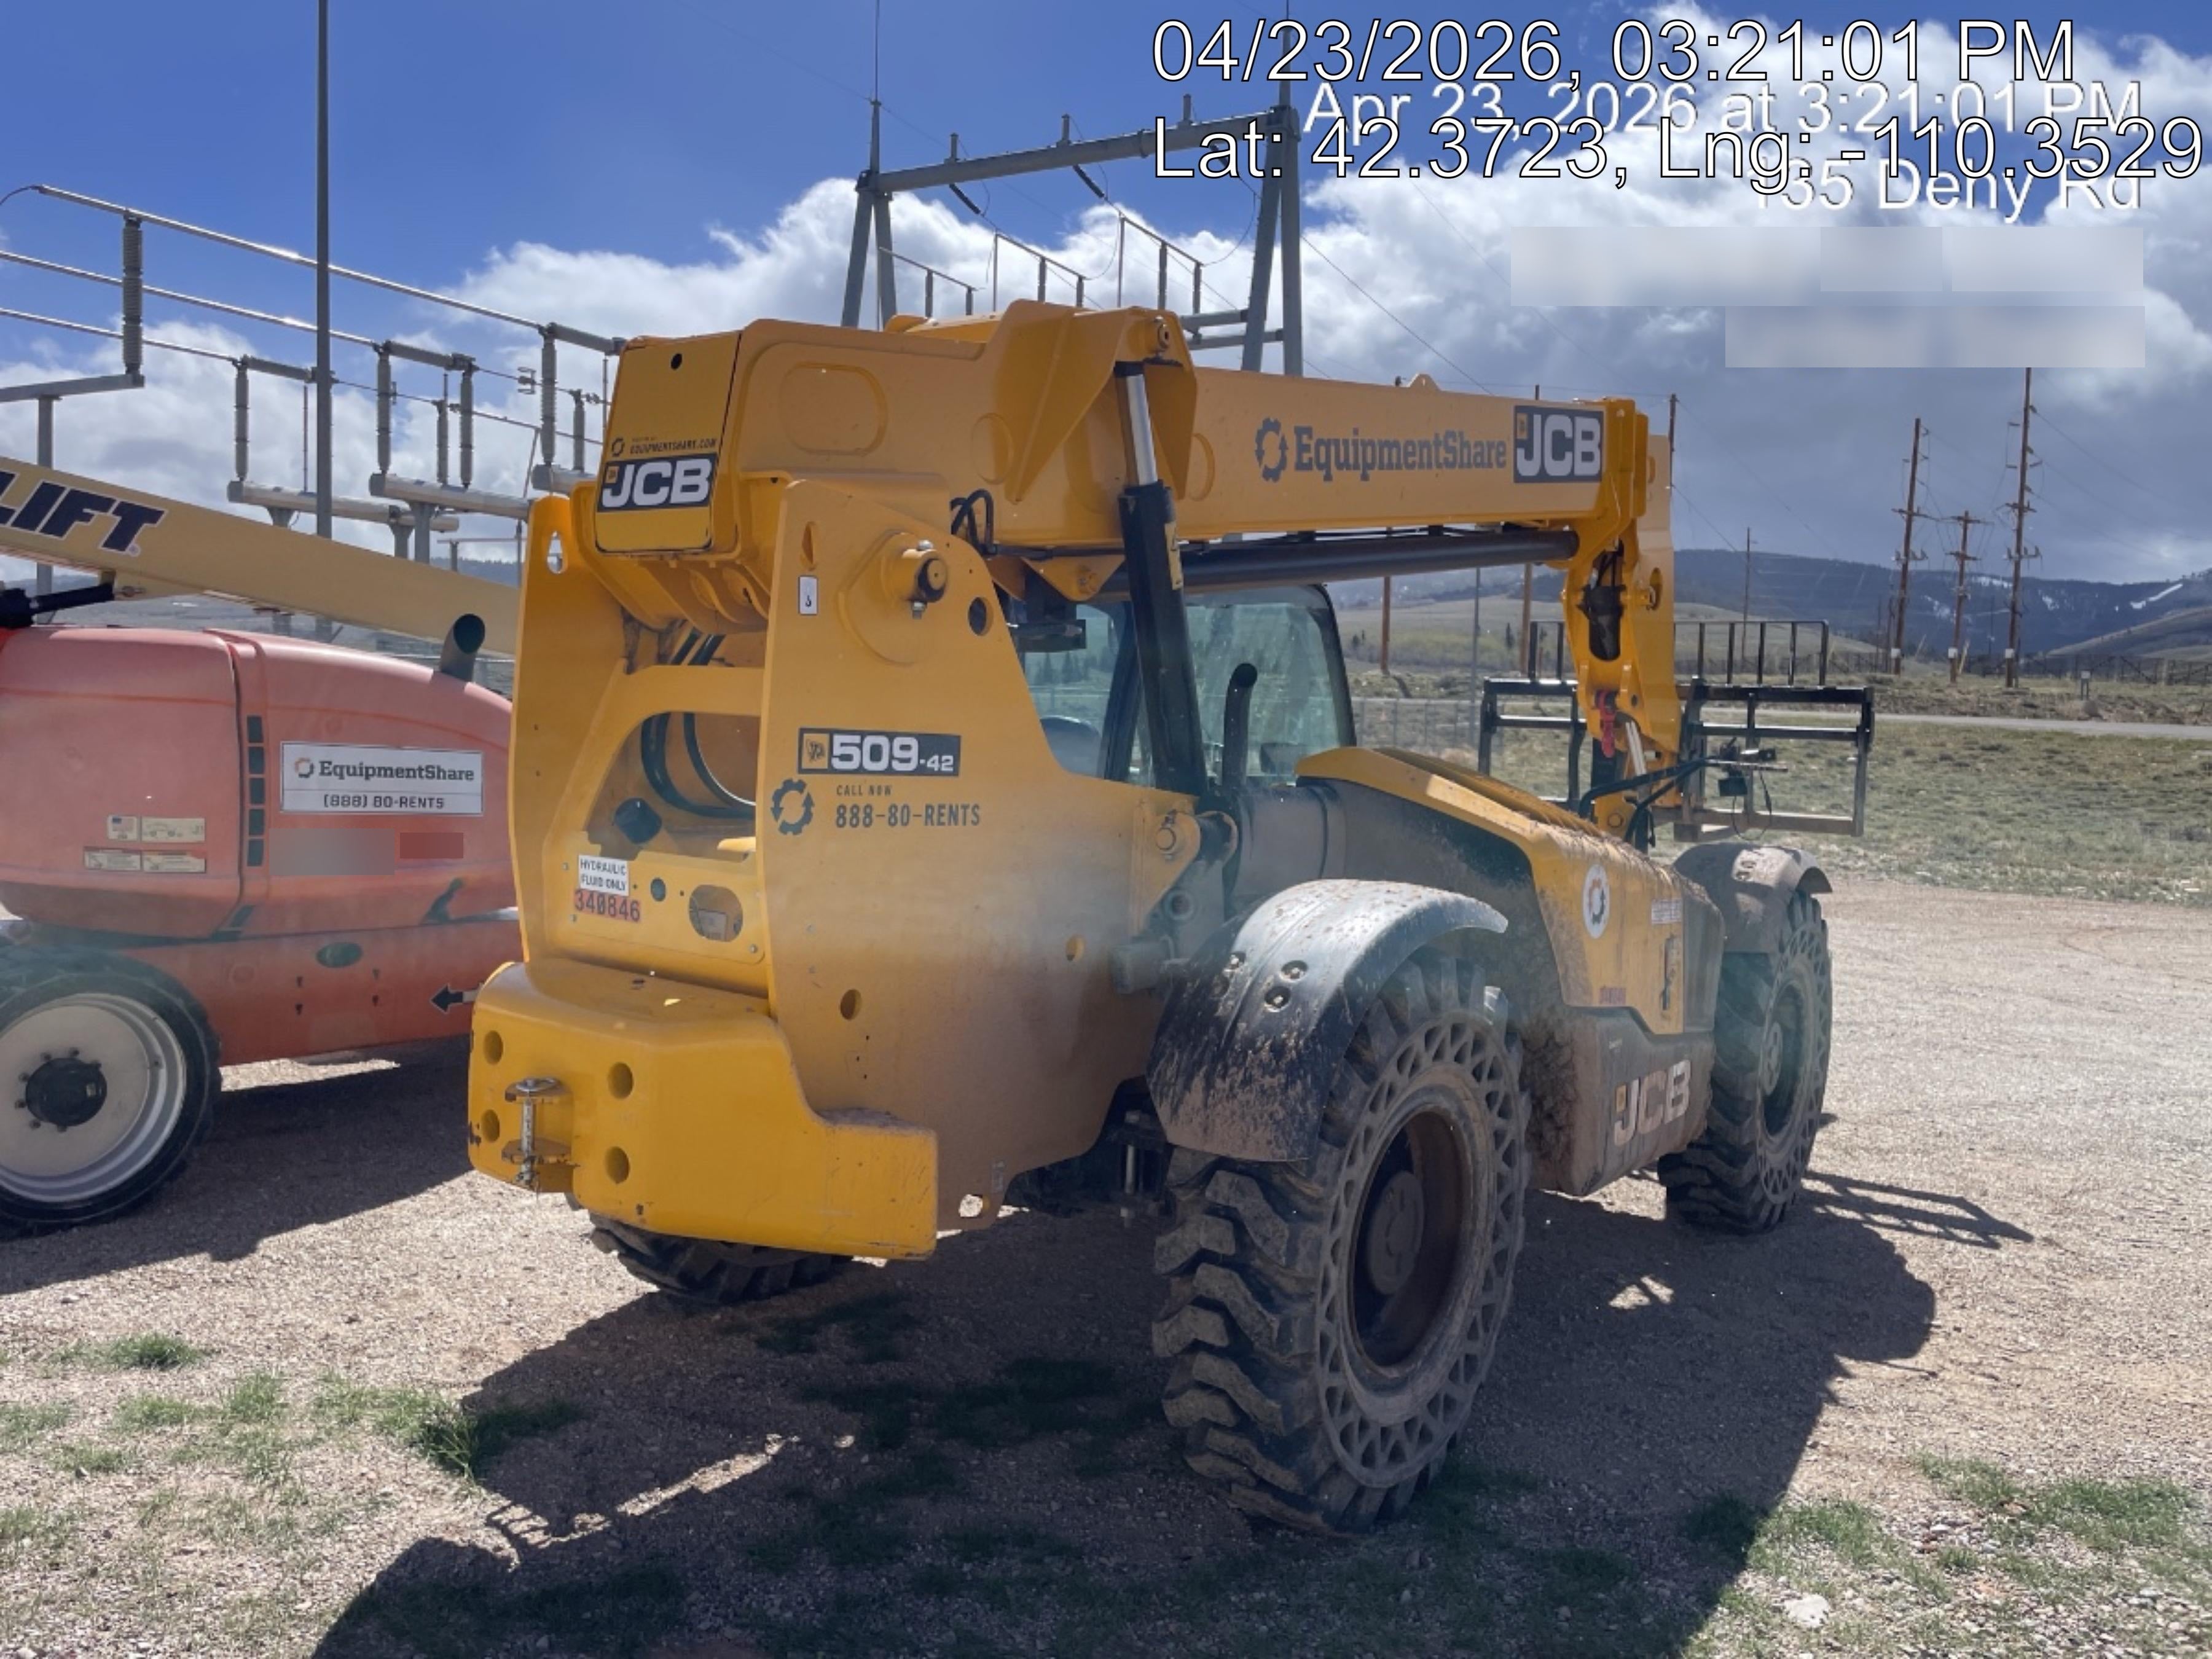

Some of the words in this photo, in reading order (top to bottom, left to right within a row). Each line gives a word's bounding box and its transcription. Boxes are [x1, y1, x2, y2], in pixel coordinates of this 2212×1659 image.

[1294, 426, 1507, 482] EquipmentShare
[1516, 414, 1601, 477] JCB
[602, 458, 712, 508] JCB
[319, 761, 474, 782] EquipmentShare
[324, 794, 367, 808] (888)
[373, 796, 444, 809] 80-RENTS
[836, 785, 863, 796] CALL
[868, 785, 893, 796] NOW
[836, 804, 981, 828] 888-80-RENTS
[580, 858, 626, 876] HYDRAULIC
[581, 873, 603, 887] FLUID
[606, 878, 626, 891] ONLY
[575, 889, 640, 922] 340846
[1614, 1059, 1691, 1148] JCB
